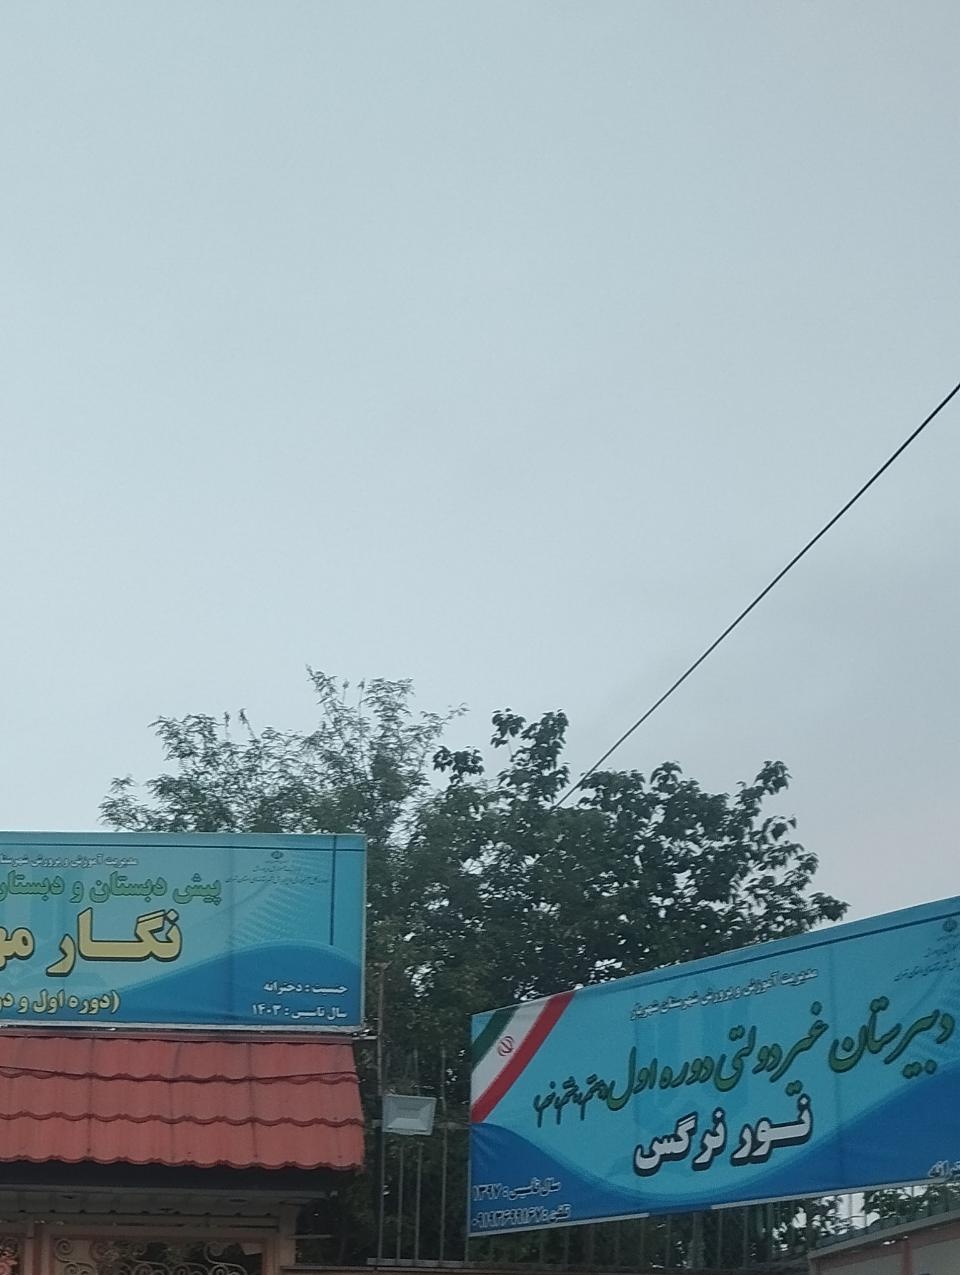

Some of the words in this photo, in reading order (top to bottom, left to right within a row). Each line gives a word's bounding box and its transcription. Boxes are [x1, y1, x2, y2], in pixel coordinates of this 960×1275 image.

[70, 880, 84, 903] و
[89, 871, 168, 903] دبستان
[173, 873, 222, 905] پیش
[45, 906, 183, 977] نگار
[32, 989, 65, 1014] اول
[68, 990, 121, 1014] (دوره
[263, 981, 303, 996] دخترانه
[16, 997, 29, 1013] و
[327, 1007, 348, 1021] سال
[828, 995, 955, 1080] دبیرستان
[606, 1045, 658, 1112] اول
[658, 1055, 715, 1089] دوره
[632, 1106, 727, 1177] نرگس
[729, 1093, 813, 1167] نور
